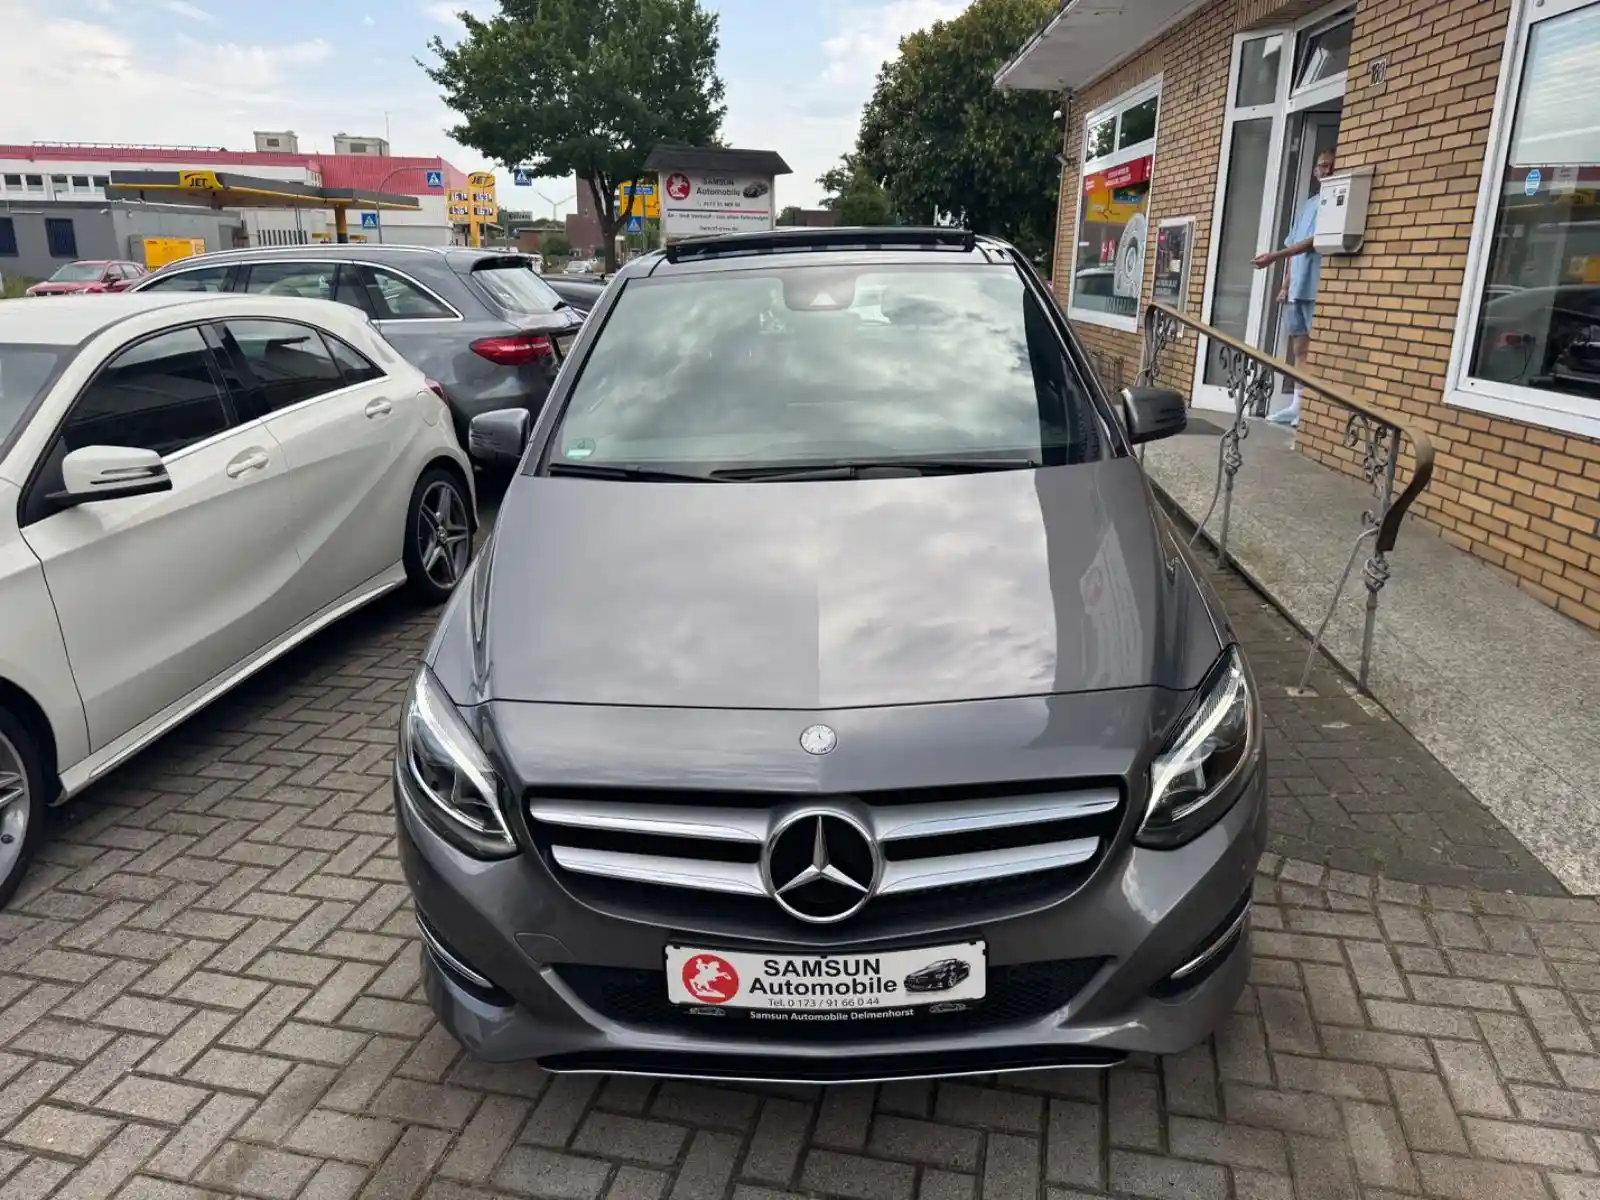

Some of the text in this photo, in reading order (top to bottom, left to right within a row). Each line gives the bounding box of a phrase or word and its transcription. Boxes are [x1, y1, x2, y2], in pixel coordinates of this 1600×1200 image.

[189, 177, 208, 188] JET
[696, 187, 741, 196] Automobile
[764, 958, 881, 978] SAMSUN
[749, 977, 898, 996] Automobile
[768, 998, 785, 1007] Tel.
[750, 1008, 914, 1021] Samsun Automobile Delmenhorst
